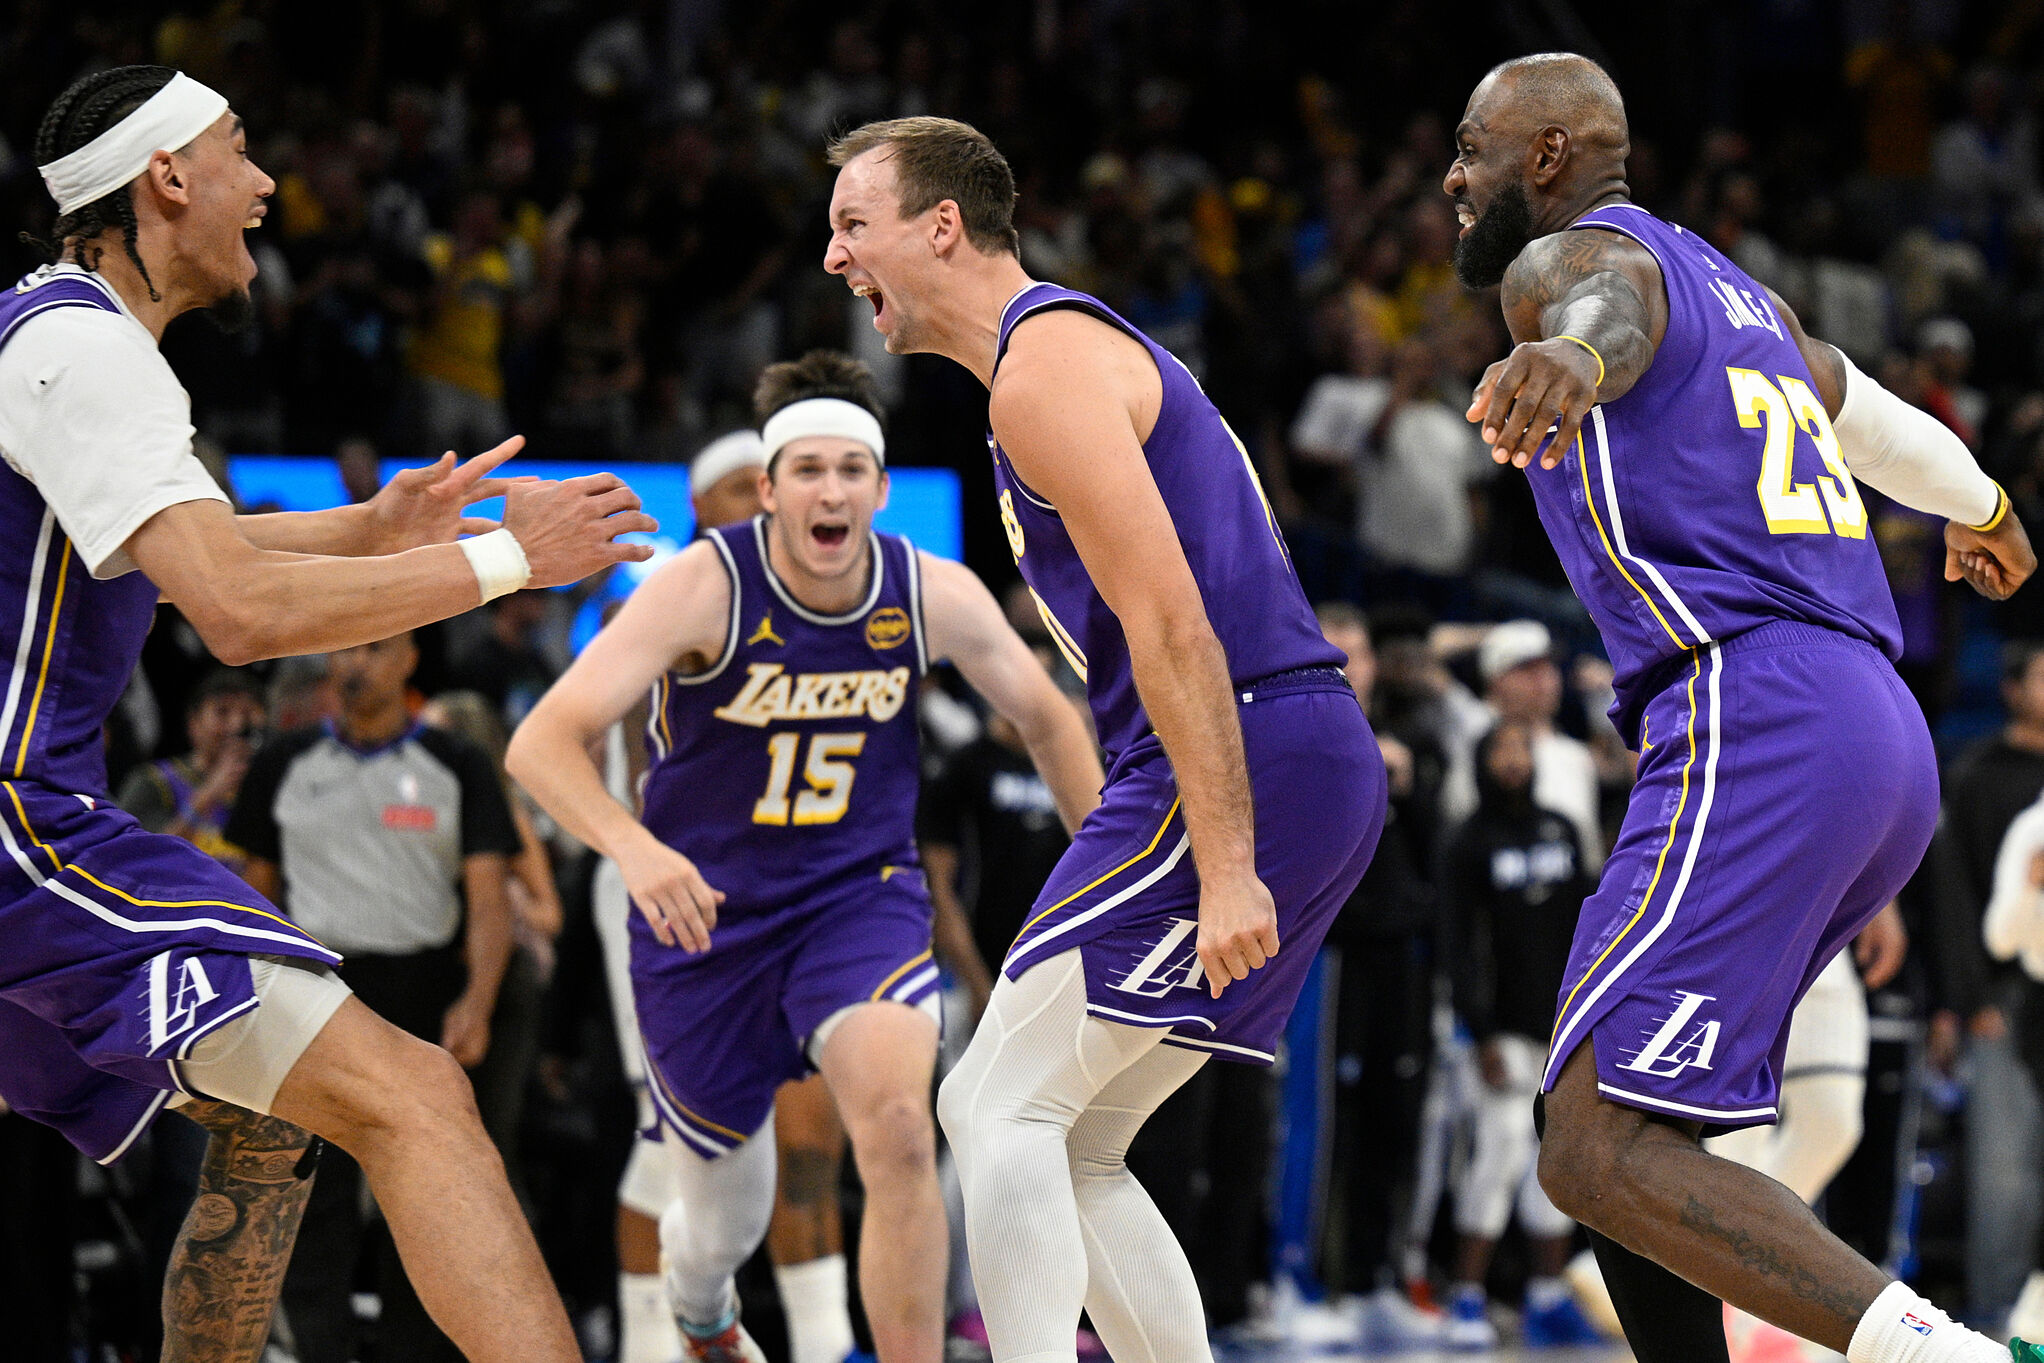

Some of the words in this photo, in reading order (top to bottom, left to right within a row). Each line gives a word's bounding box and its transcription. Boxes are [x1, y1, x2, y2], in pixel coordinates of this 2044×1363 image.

[1726, 366, 1868, 540] 23
[714, 662, 911, 727] LAKERS
[752, 732, 867, 826] 15
[141, 950, 221, 1058] LA
[1615, 989, 1721, 1079] LA
